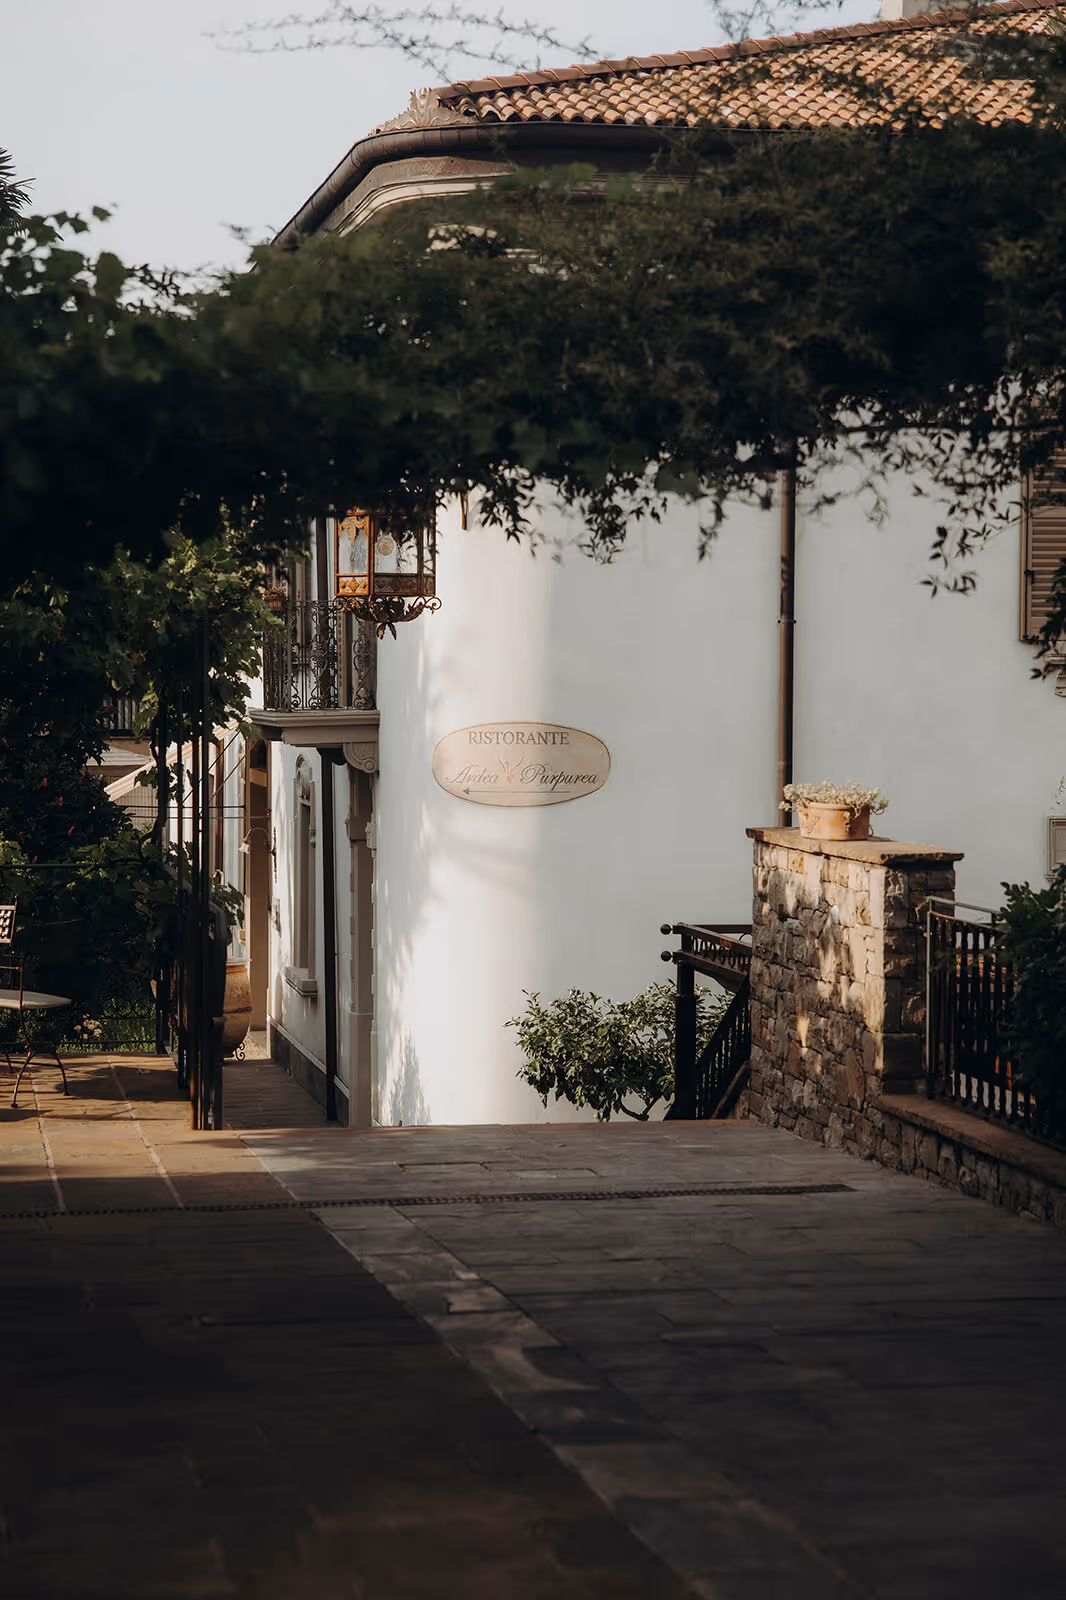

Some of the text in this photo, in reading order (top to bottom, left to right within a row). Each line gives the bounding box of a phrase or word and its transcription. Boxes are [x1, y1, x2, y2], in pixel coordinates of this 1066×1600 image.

[468, 731, 570, 745] RISTORANTE
[445, 763, 599, 791] Ardea Purpurea
